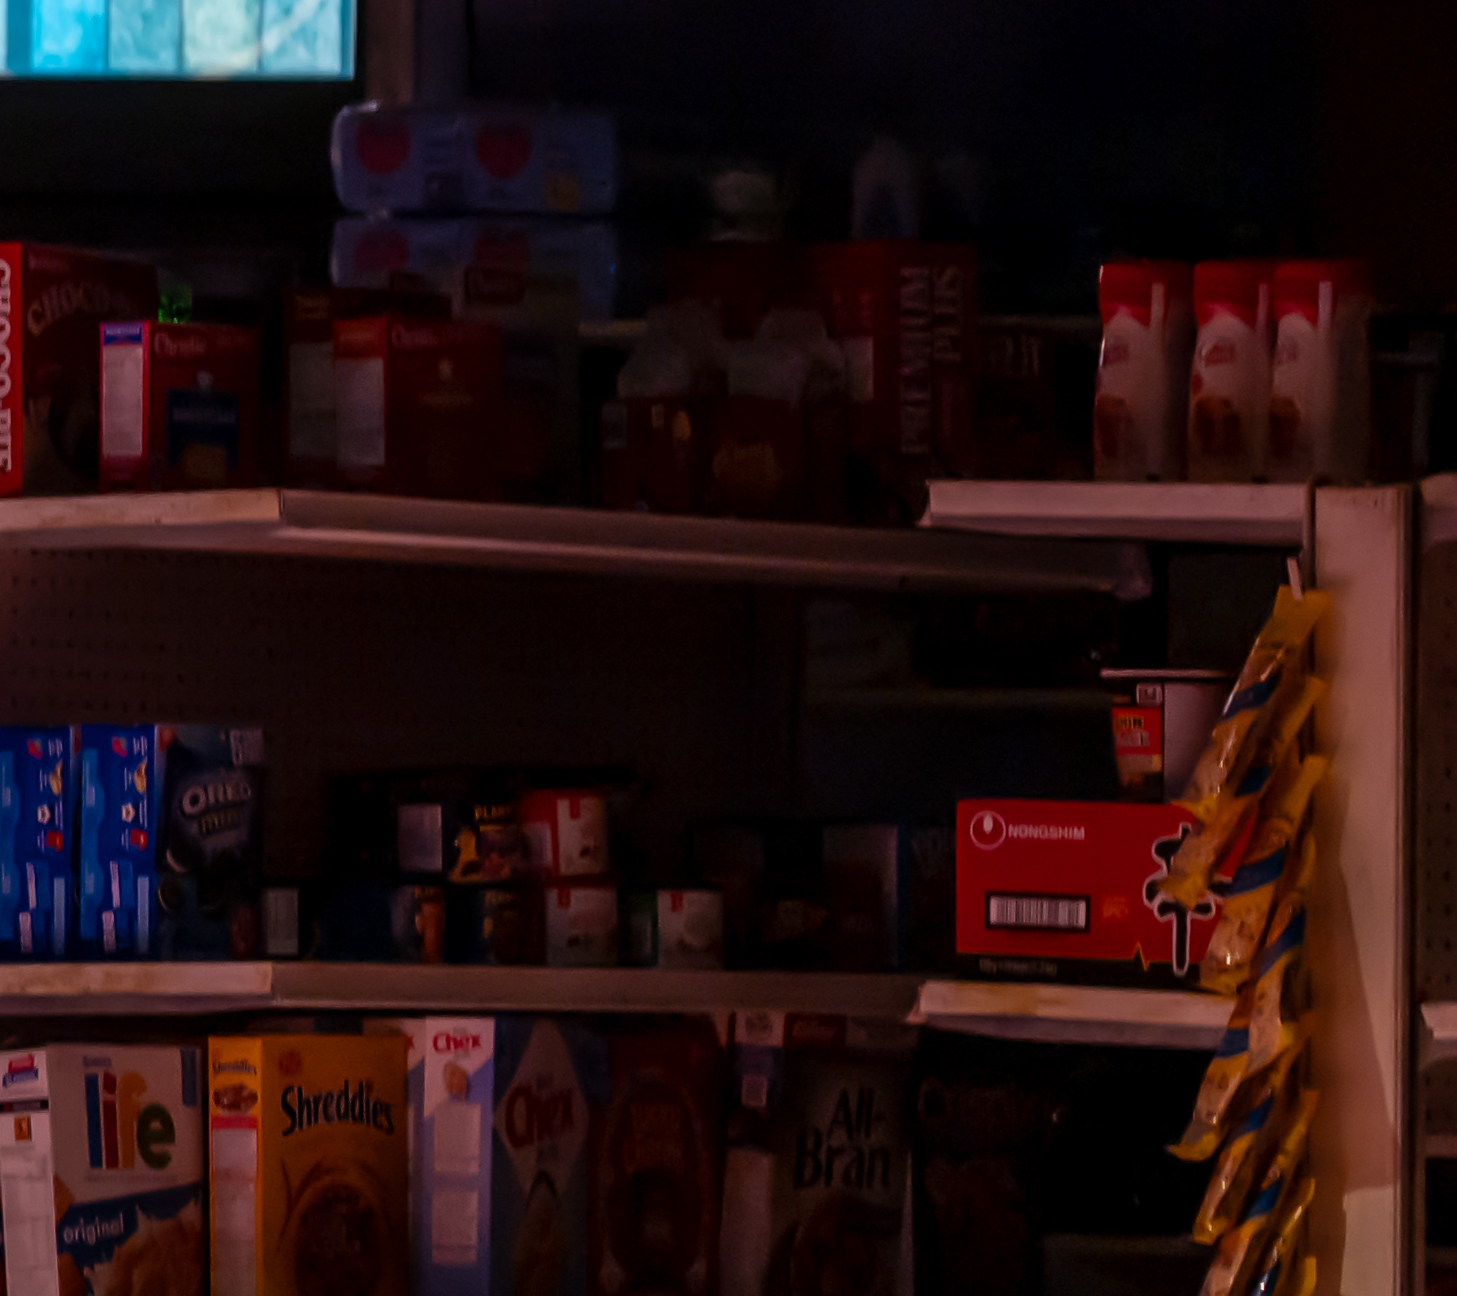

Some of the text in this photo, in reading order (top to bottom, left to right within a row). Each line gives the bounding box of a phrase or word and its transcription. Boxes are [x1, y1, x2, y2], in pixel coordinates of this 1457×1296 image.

[1007, 823, 1086, 841] NONGSHIM
[432, 1034, 481, 1053] Chex
[83, 1071, 176, 1170] life
[280, 1078, 394, 1136] Shreddies
[505, 1085, 575, 1148] Chex
[830, 1087, 884, 1142] All-
[792, 1128, 892, 1189] Bran
[62, 1211, 126, 1248] original
